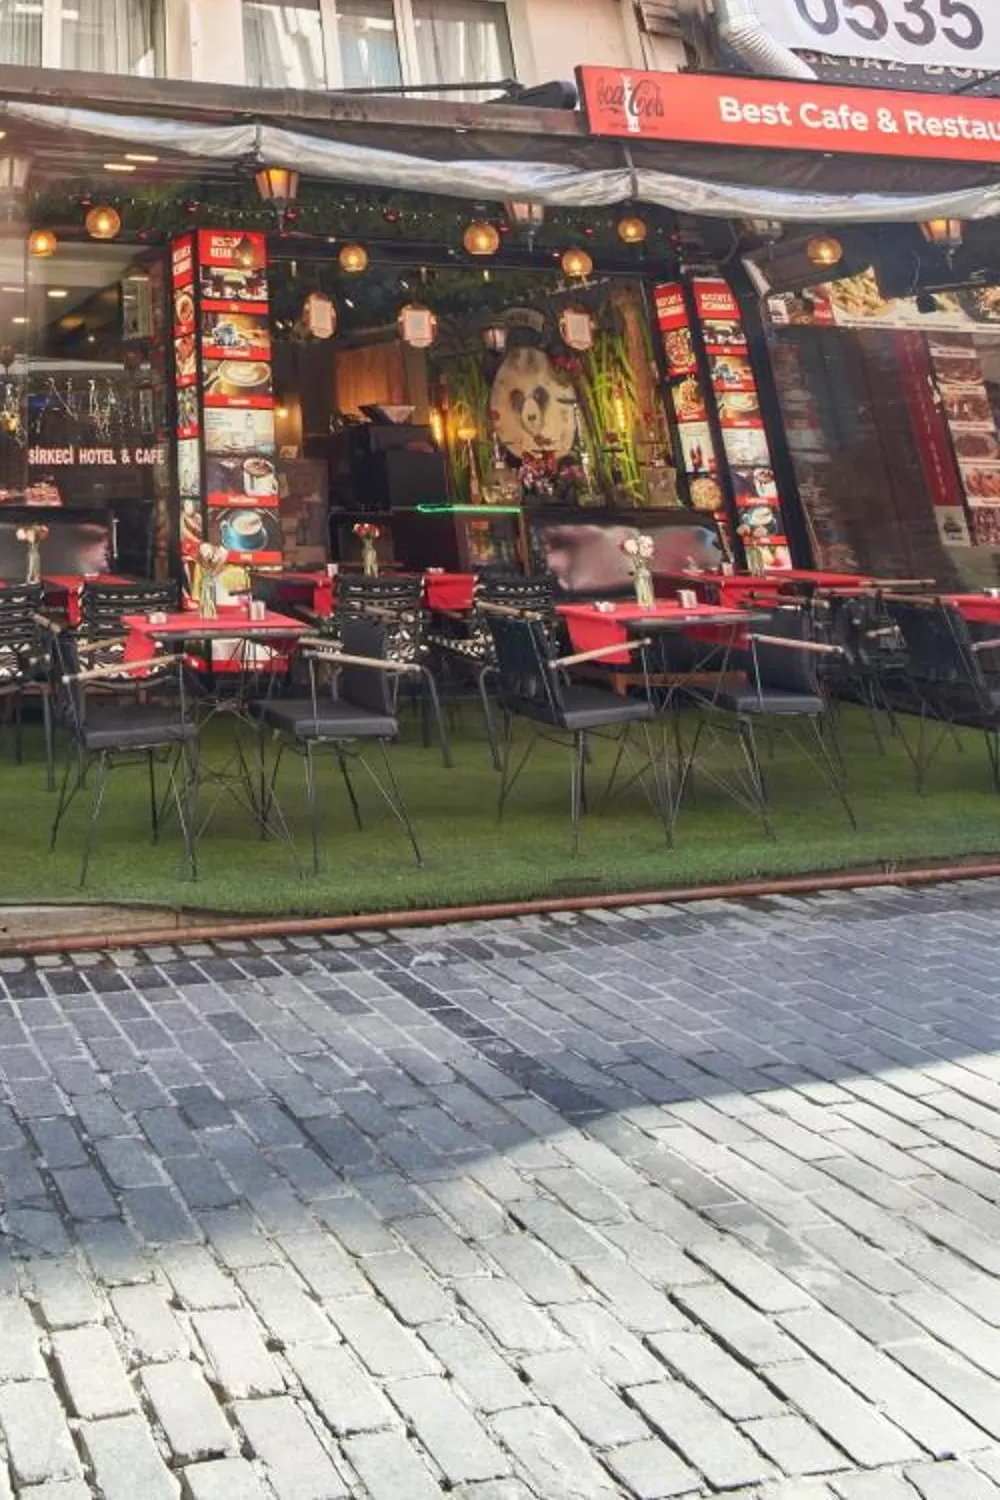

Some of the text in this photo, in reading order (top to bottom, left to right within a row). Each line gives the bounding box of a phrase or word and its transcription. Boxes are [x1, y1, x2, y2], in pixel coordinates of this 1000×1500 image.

[718, 95, 793, 126] Best
[799, 102, 869, 132] Cafe
[876, 107, 899, 134] &
[79, 448, 117, 465] HOTEL
[135, 449, 165, 465] CAFE
